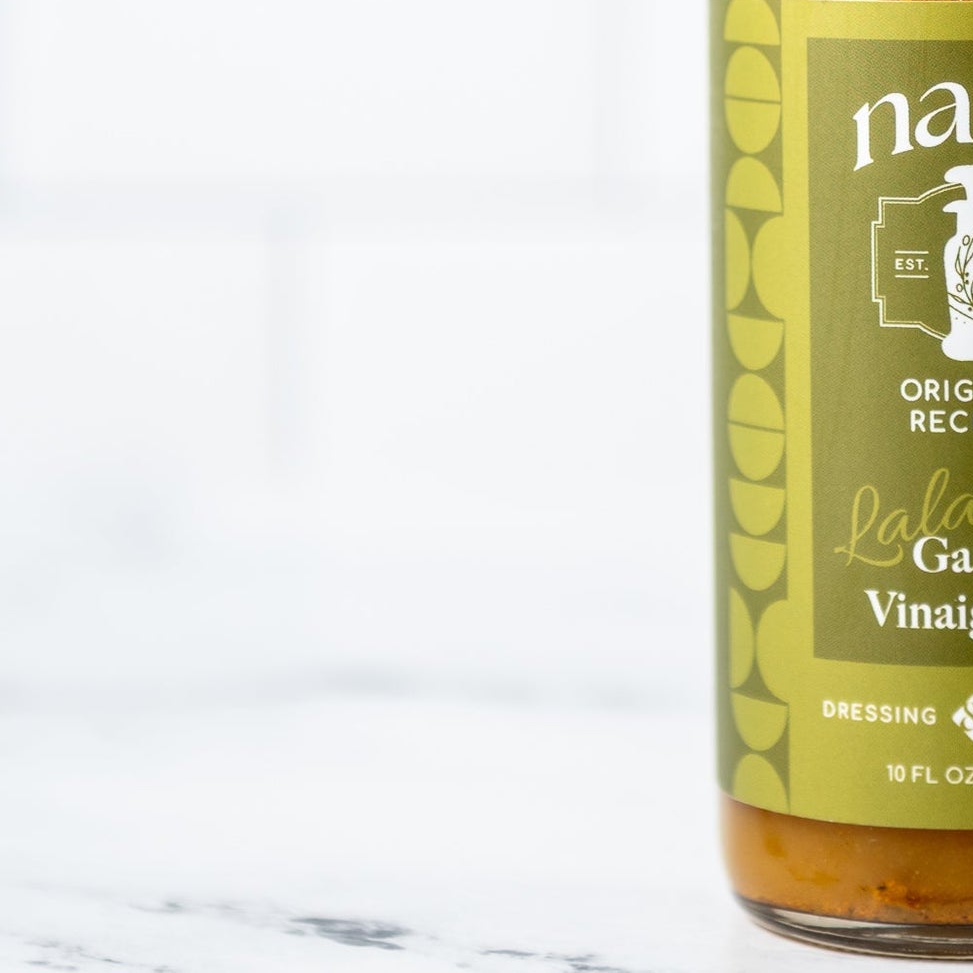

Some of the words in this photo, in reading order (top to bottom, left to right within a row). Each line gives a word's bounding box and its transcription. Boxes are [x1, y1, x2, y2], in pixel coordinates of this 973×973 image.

[894, 257, 930, 271] EST.
[821, 699, 937, 726] DRESSING
[886, 764, 906, 783] 10
[911, 765, 939, 784] FL
